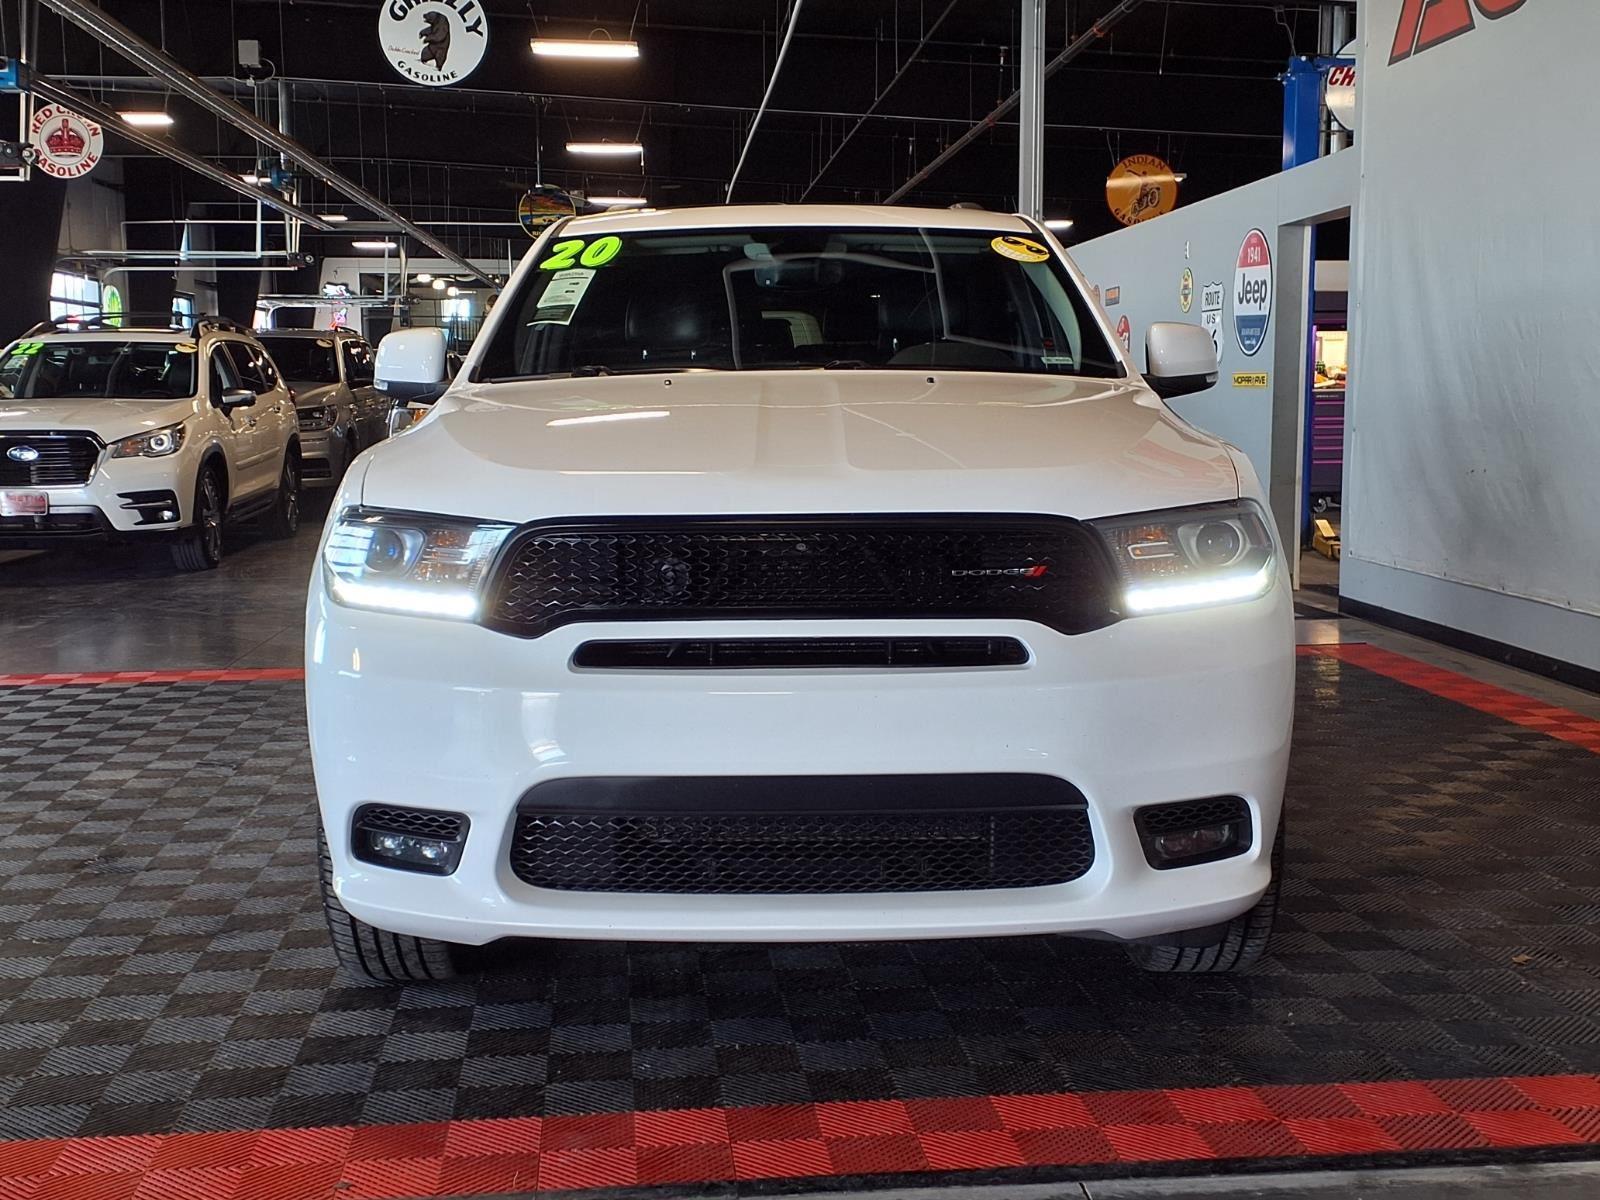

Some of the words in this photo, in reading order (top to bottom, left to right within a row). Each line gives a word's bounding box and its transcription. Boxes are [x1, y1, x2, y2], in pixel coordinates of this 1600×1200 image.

[397, 60, 458, 82] GASOLINE
[1328, 65, 1355, 87] CH
[1122, 156, 1167, 171] INDIAN
[539, 236, 622, 270] 20
[1247, 244, 1261, 264] 1941
[1204, 290, 1220, 306] ROUTE
[1238, 273, 1268, 311] Jeep
[1206, 313, 1216, 325] US
[11, 342, 45, 355] 22
[951, 568, 1035, 577] DODGE
